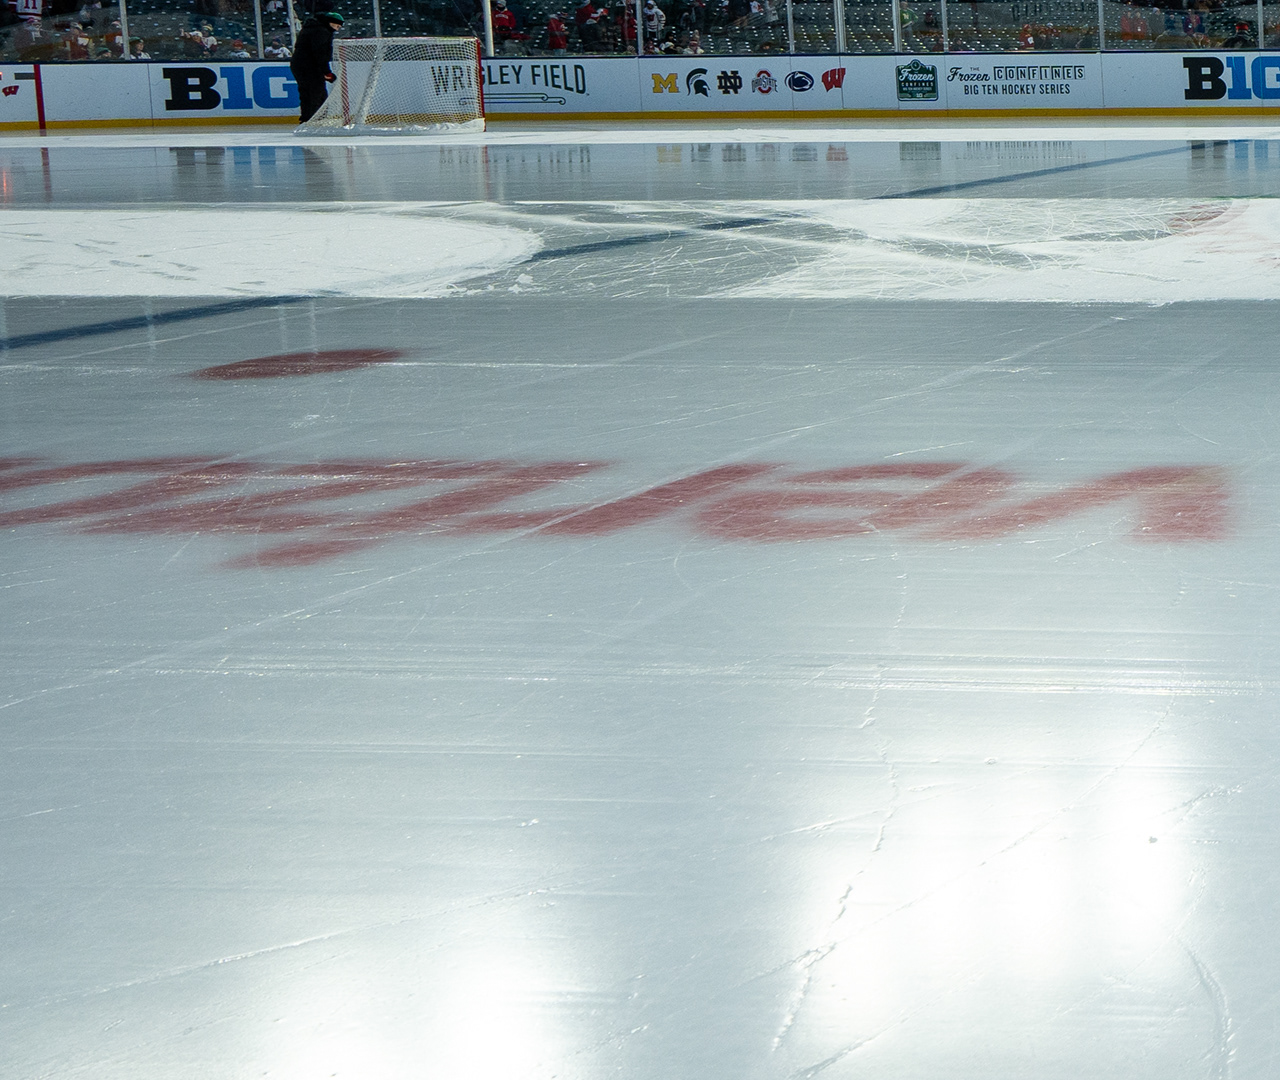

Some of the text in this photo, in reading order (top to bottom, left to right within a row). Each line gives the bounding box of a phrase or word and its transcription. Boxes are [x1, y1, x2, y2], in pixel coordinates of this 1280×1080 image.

[531, 64, 587, 94] FIELD
[898, 68, 934, 81] Frozen
[946, 66, 1085, 82] Frozen CONFINES
[651, 73, 679, 94] M
[964, 83, 1071, 95] BIG TEN HOCKEY SERIES
[0, 453, 1236, 570] verizo
